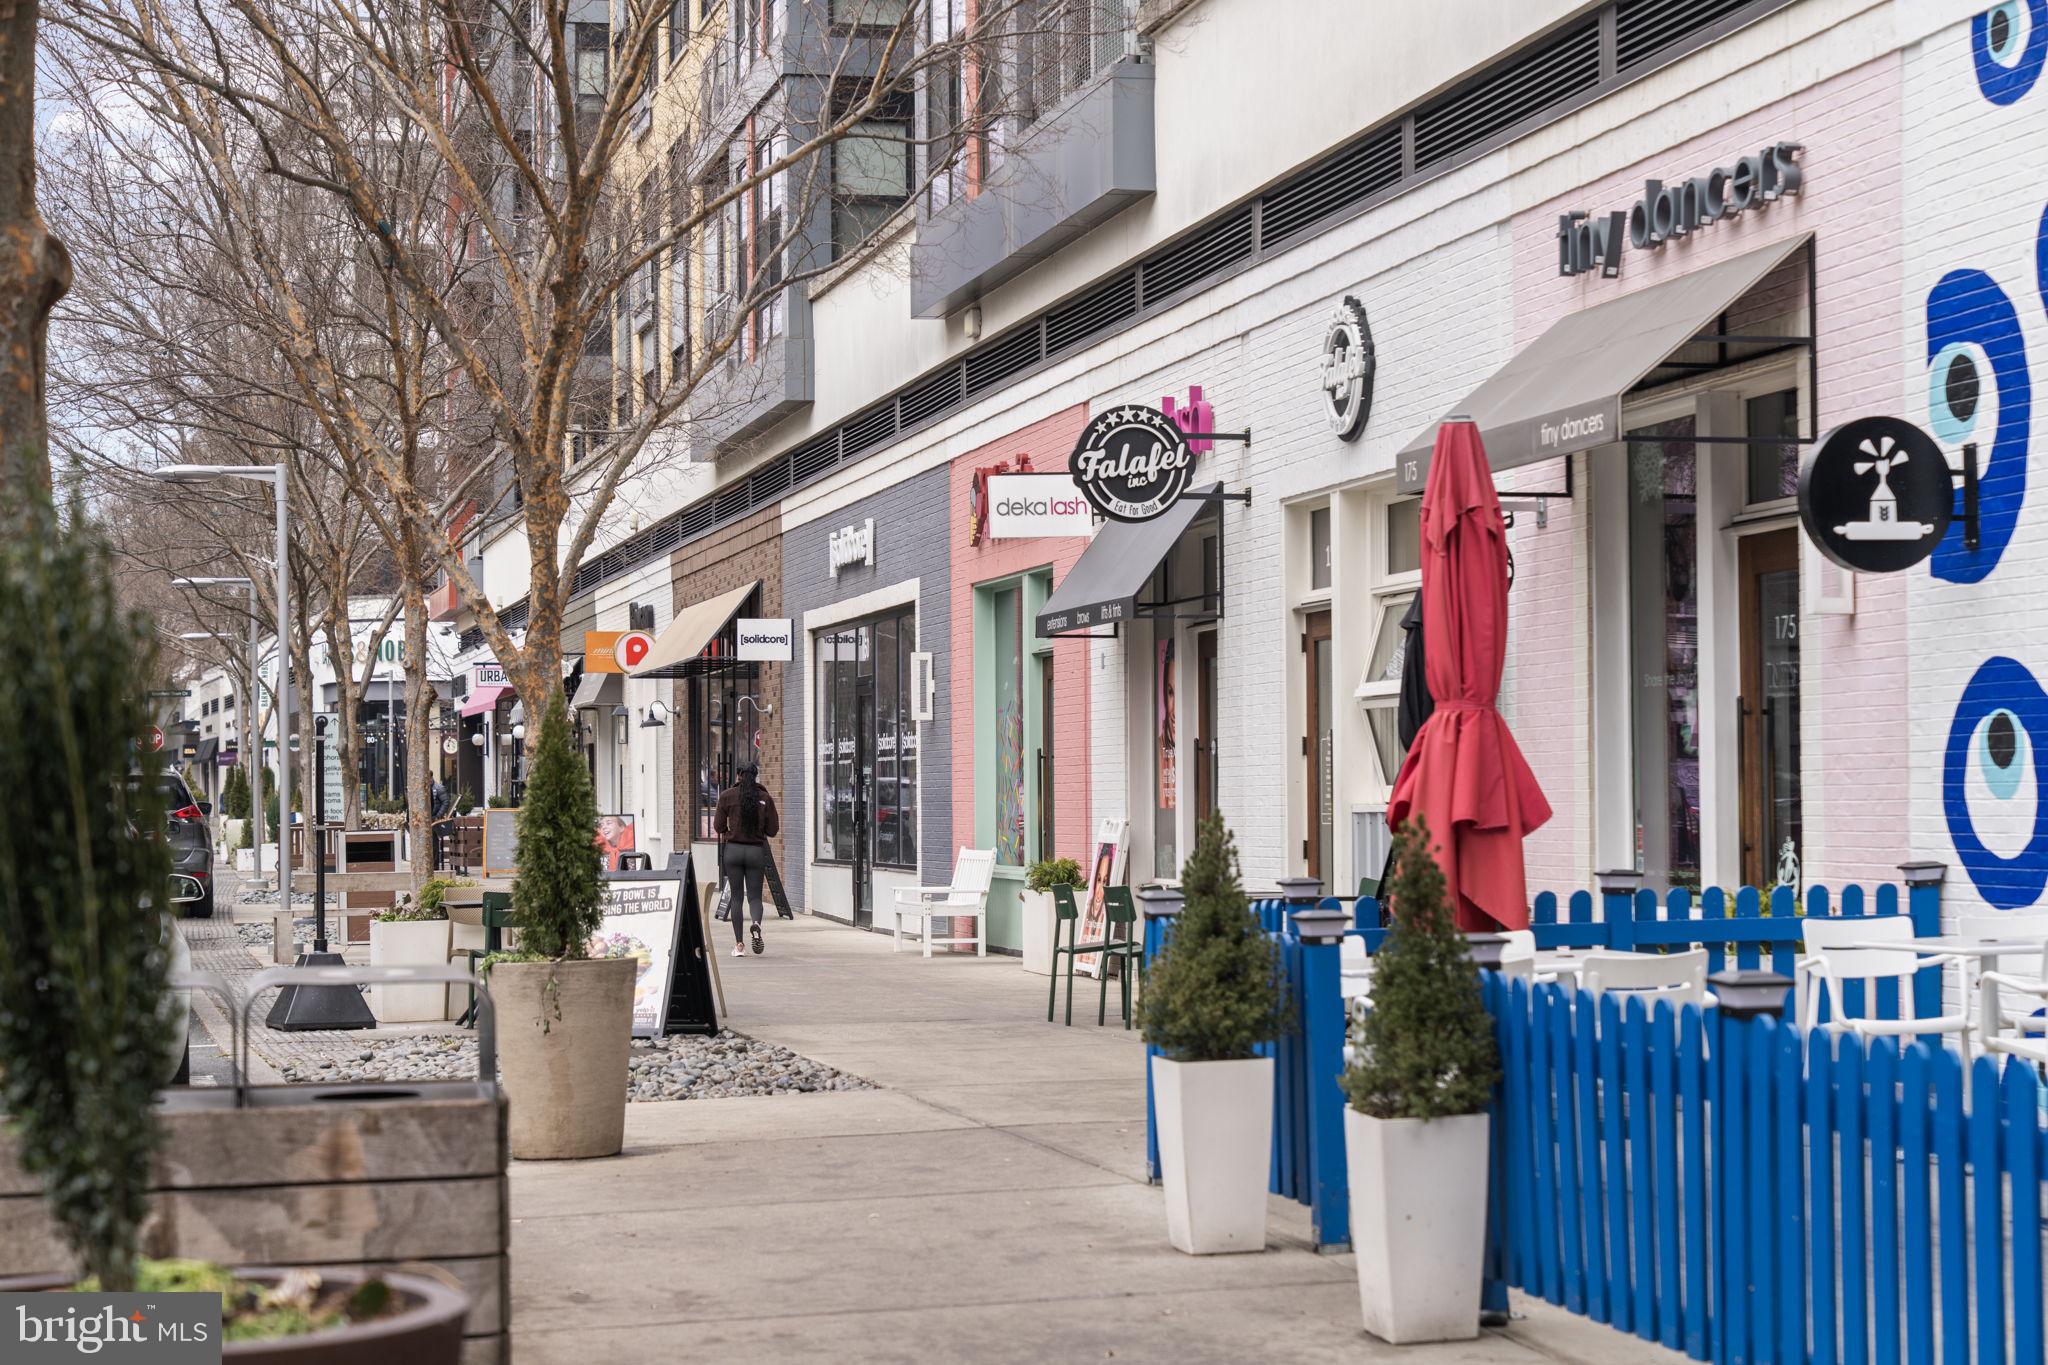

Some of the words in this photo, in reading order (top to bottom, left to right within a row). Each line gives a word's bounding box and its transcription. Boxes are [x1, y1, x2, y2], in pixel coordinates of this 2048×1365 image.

[1556, 210, 1627, 278] tiny
[1631, 141, 1804, 249] dancers
[1541, 421, 1560, 447] tiny
[1561, 413, 1604, 440] dancers
[1078, 441, 1190, 482] Falafel
[1404, 461, 1418, 482] 175
[1127, 474, 1148, 489] inc
[1114, 500, 1127, 514] Eat
[1140, 501, 1158, 515] Good
[1076, 610, 1090, 625] brows
[1774, 613, 1797, 640] 175
[740, 634, 788, 646] [solidcore]
[623, 889, 646, 900] BOWL
[648, 888, 657, 899] IS
[624, 902, 640, 913] THE
[641, 899, 670, 912] WORLD
